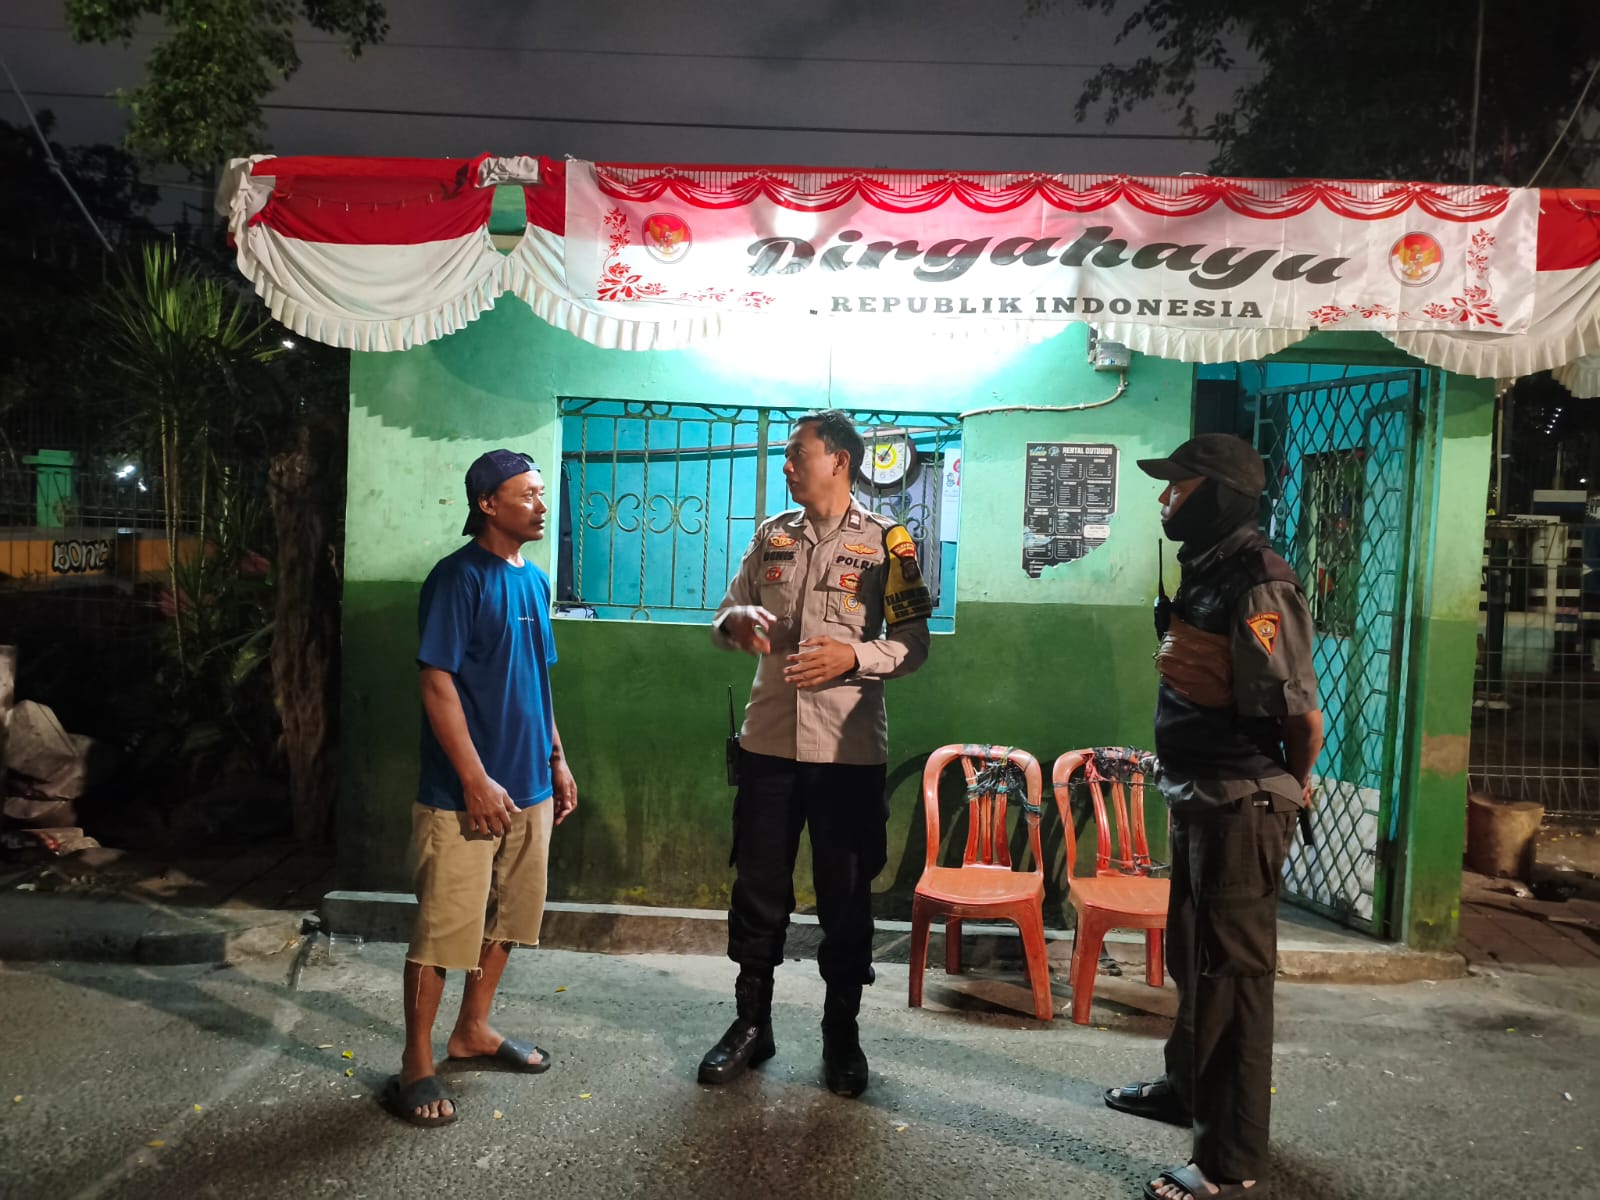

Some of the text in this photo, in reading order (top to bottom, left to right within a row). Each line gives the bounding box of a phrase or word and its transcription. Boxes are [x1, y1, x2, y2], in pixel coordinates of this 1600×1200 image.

[747, 227, 1351, 289] Dirgahayu
[833, 296, 1262, 318] REPUBLIK INDONESIA
[1085, 447, 1113, 455] OUTDOOR
[836, 555, 874, 572] POLRI
